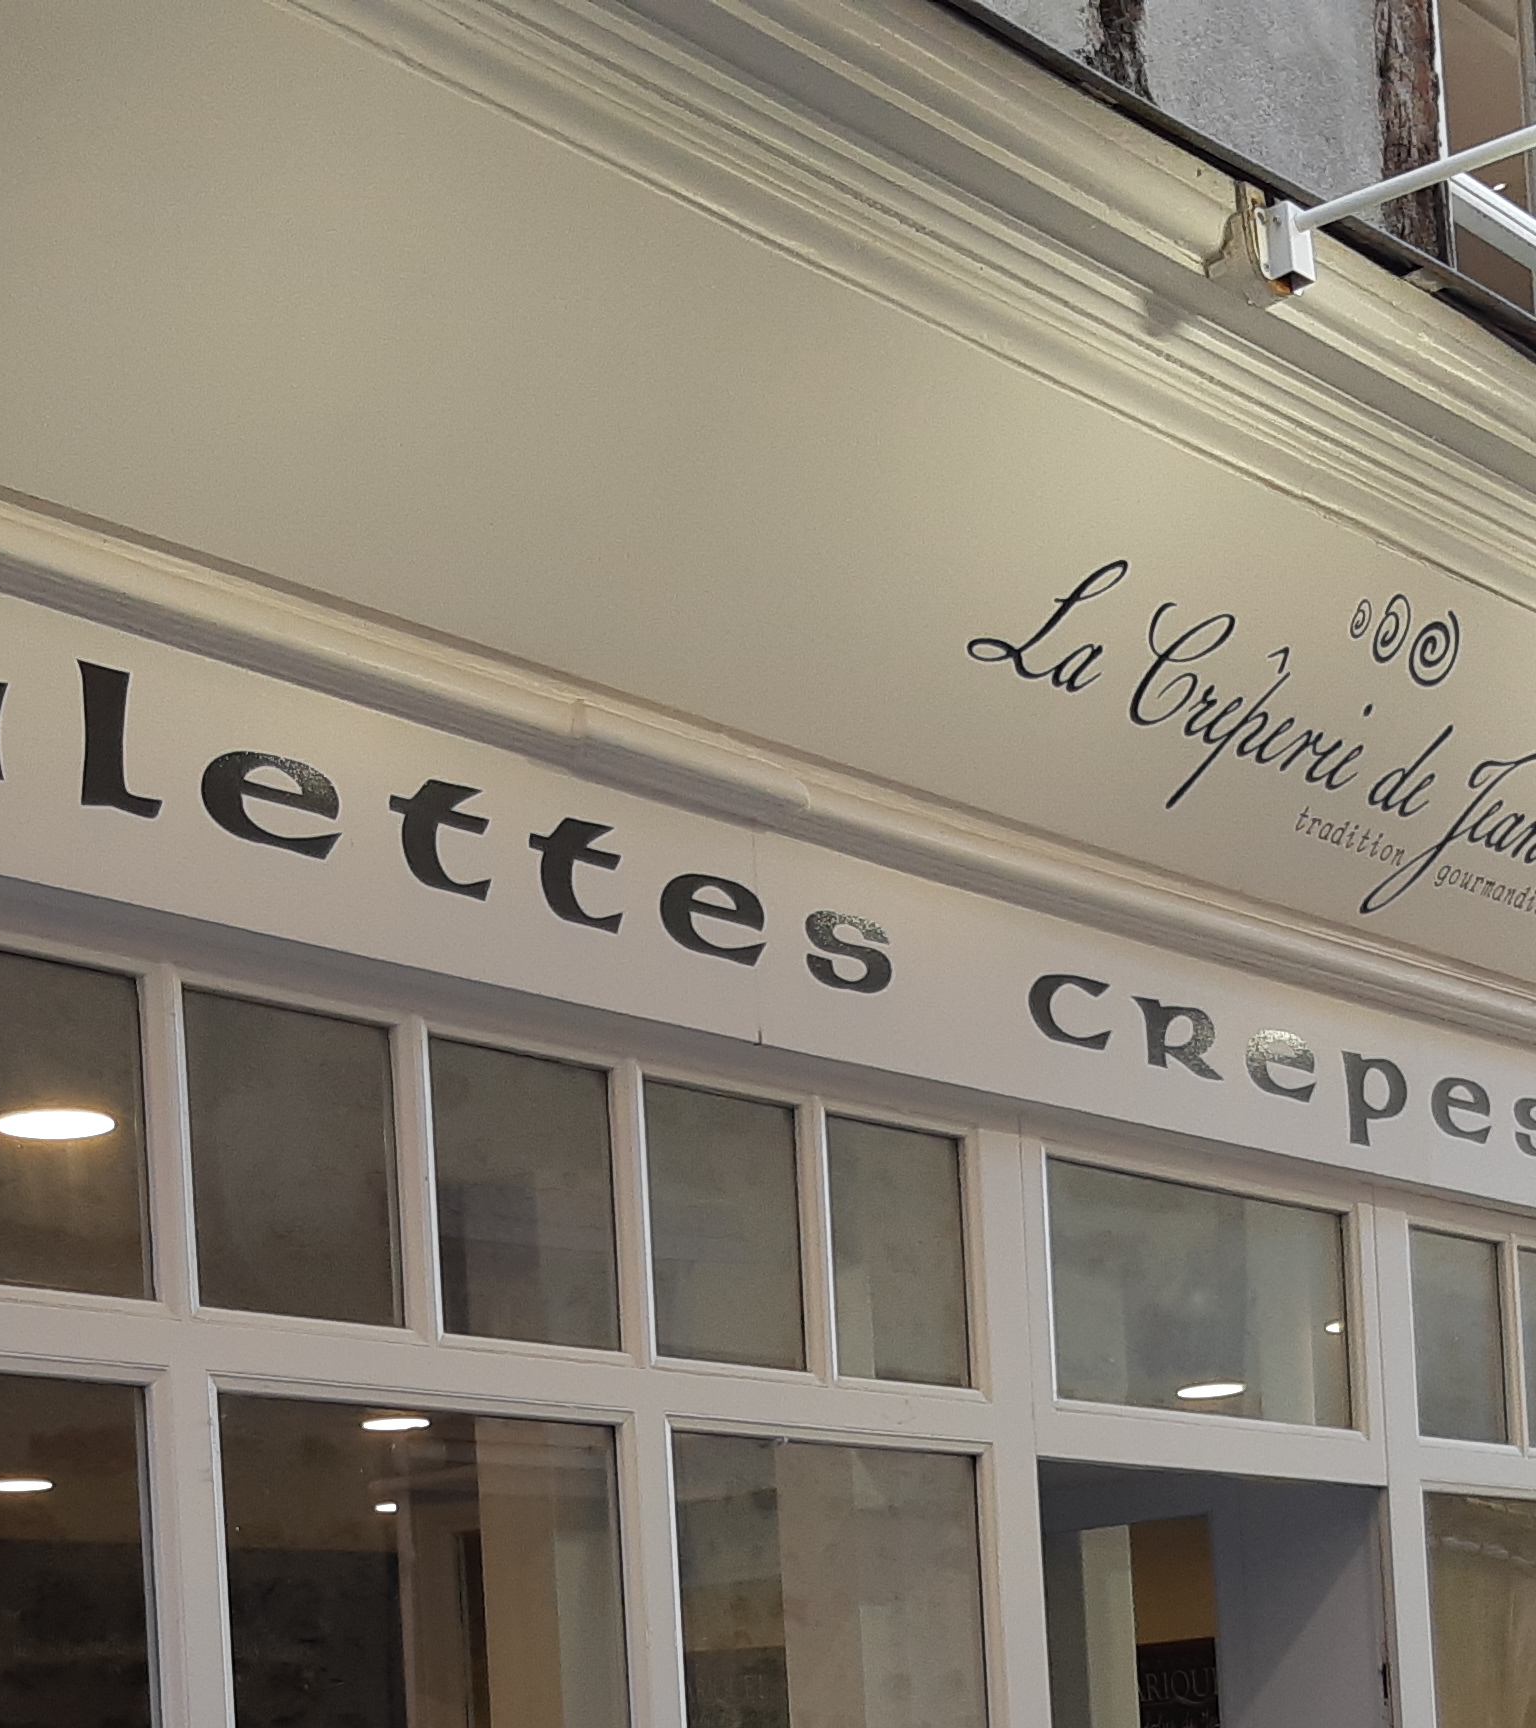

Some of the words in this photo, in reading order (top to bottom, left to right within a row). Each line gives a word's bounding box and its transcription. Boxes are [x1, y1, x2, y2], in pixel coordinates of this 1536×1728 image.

[965, 558, 1129, 694] La
[1127, 601, 1372, 809] Crêperie
[1367, 723, 1454, 818] de
[1295, 806, 1407, 868] tradition
